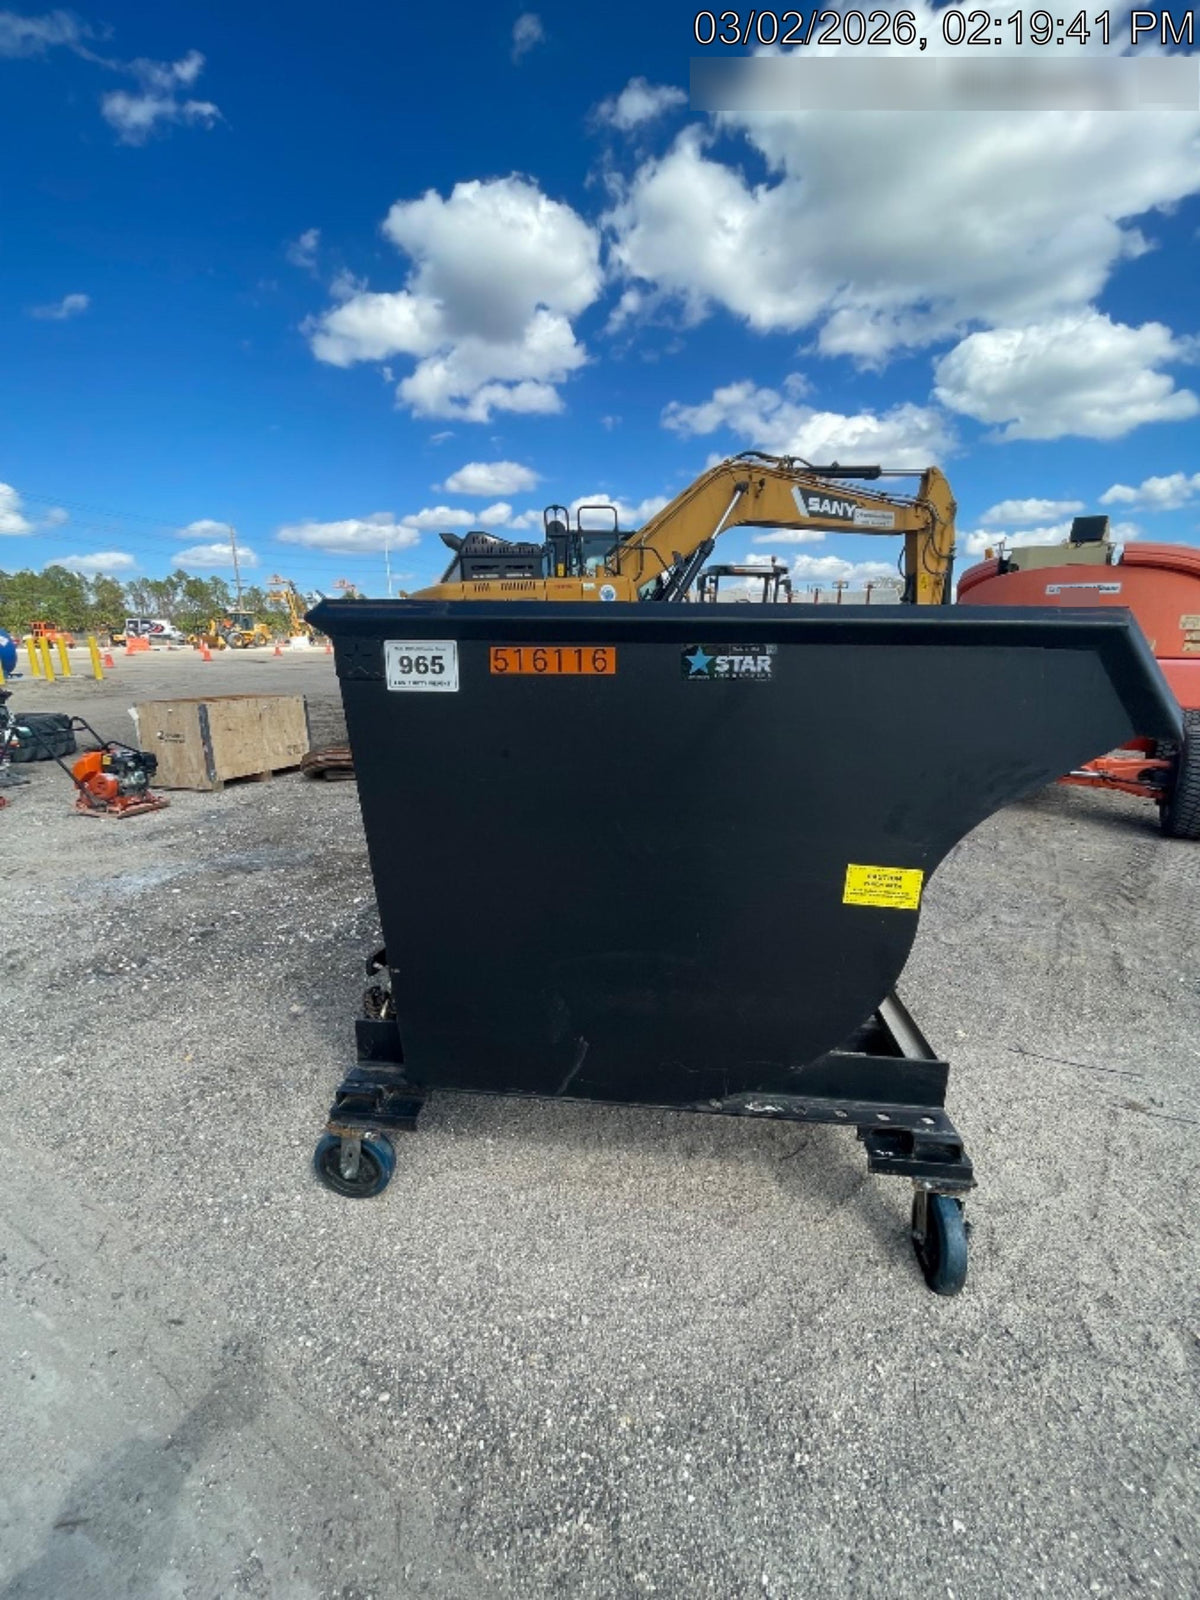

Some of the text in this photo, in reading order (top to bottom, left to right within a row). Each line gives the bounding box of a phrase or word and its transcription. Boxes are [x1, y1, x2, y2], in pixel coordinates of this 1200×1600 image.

[808, 497, 856, 518] SANY
[399, 655, 445, 674] 965
[494, 648, 608, 672] 516116
[714, 655, 772, 673] STAR
